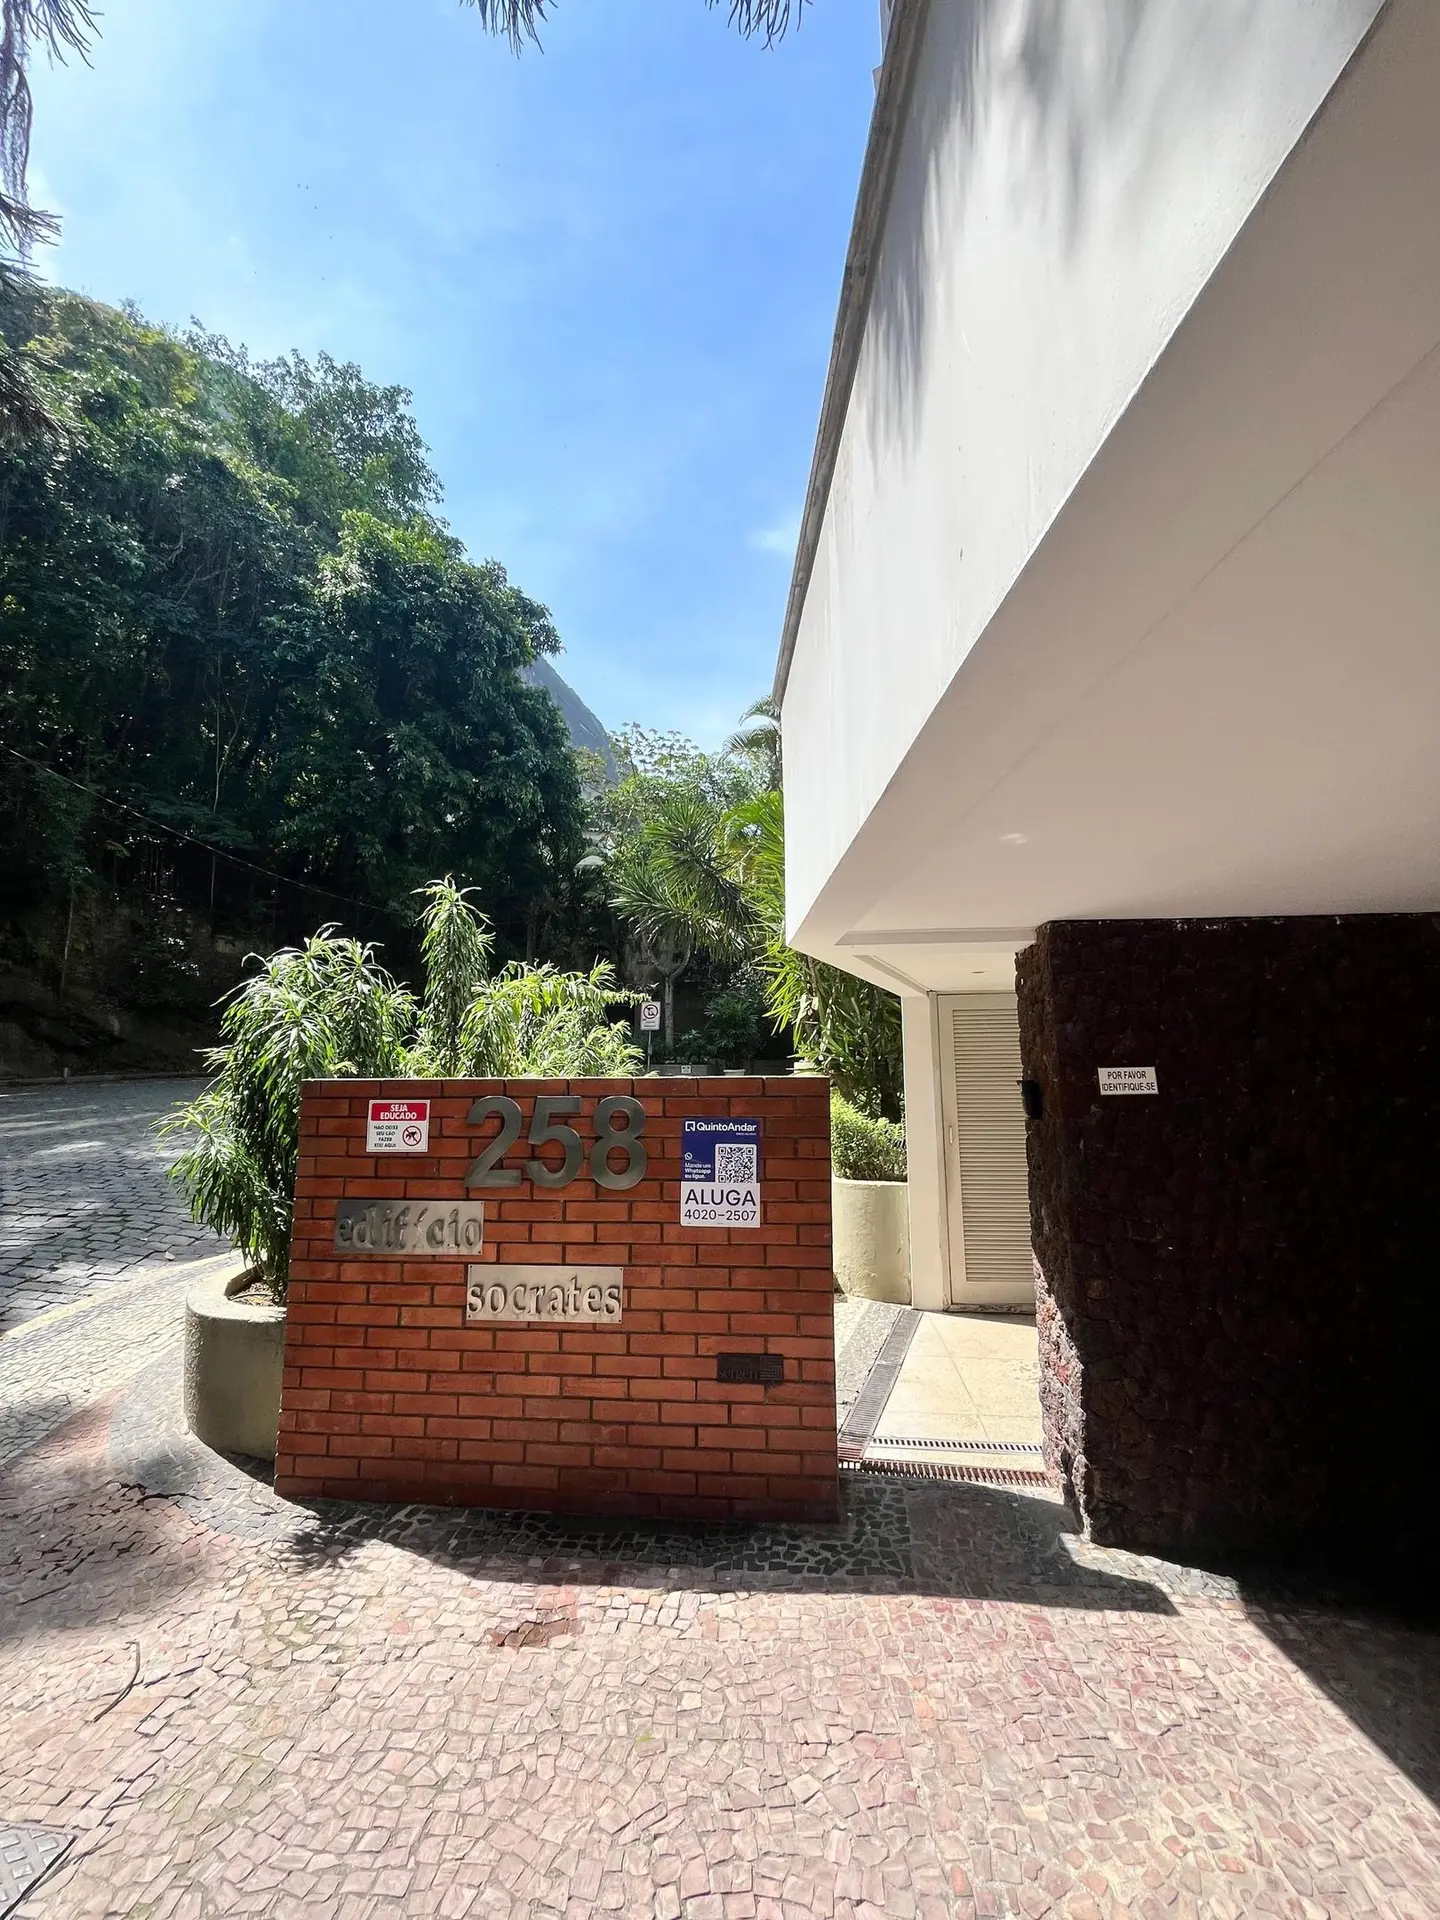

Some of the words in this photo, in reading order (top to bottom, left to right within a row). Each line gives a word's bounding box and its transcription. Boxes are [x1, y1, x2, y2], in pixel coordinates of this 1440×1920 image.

[1107, 1071, 1122, 1080] POR
[1124, 1070, 1147, 1079] FAVOR
[1102, 1081, 1156, 1092] IDENTIFIQUE-SE
[390, 1104, 408, 1112] SEJA
[380, 1112, 417, 1120] EDUCADO
[696, 1122, 757, 1132] QuintoAndar
[464, 1095, 648, 1190] 258
[684, 1188, 757, 1206] ALUGA
[684, 1209, 757, 1221] 4020-2507
[467, 1275, 622, 1317] socrates
